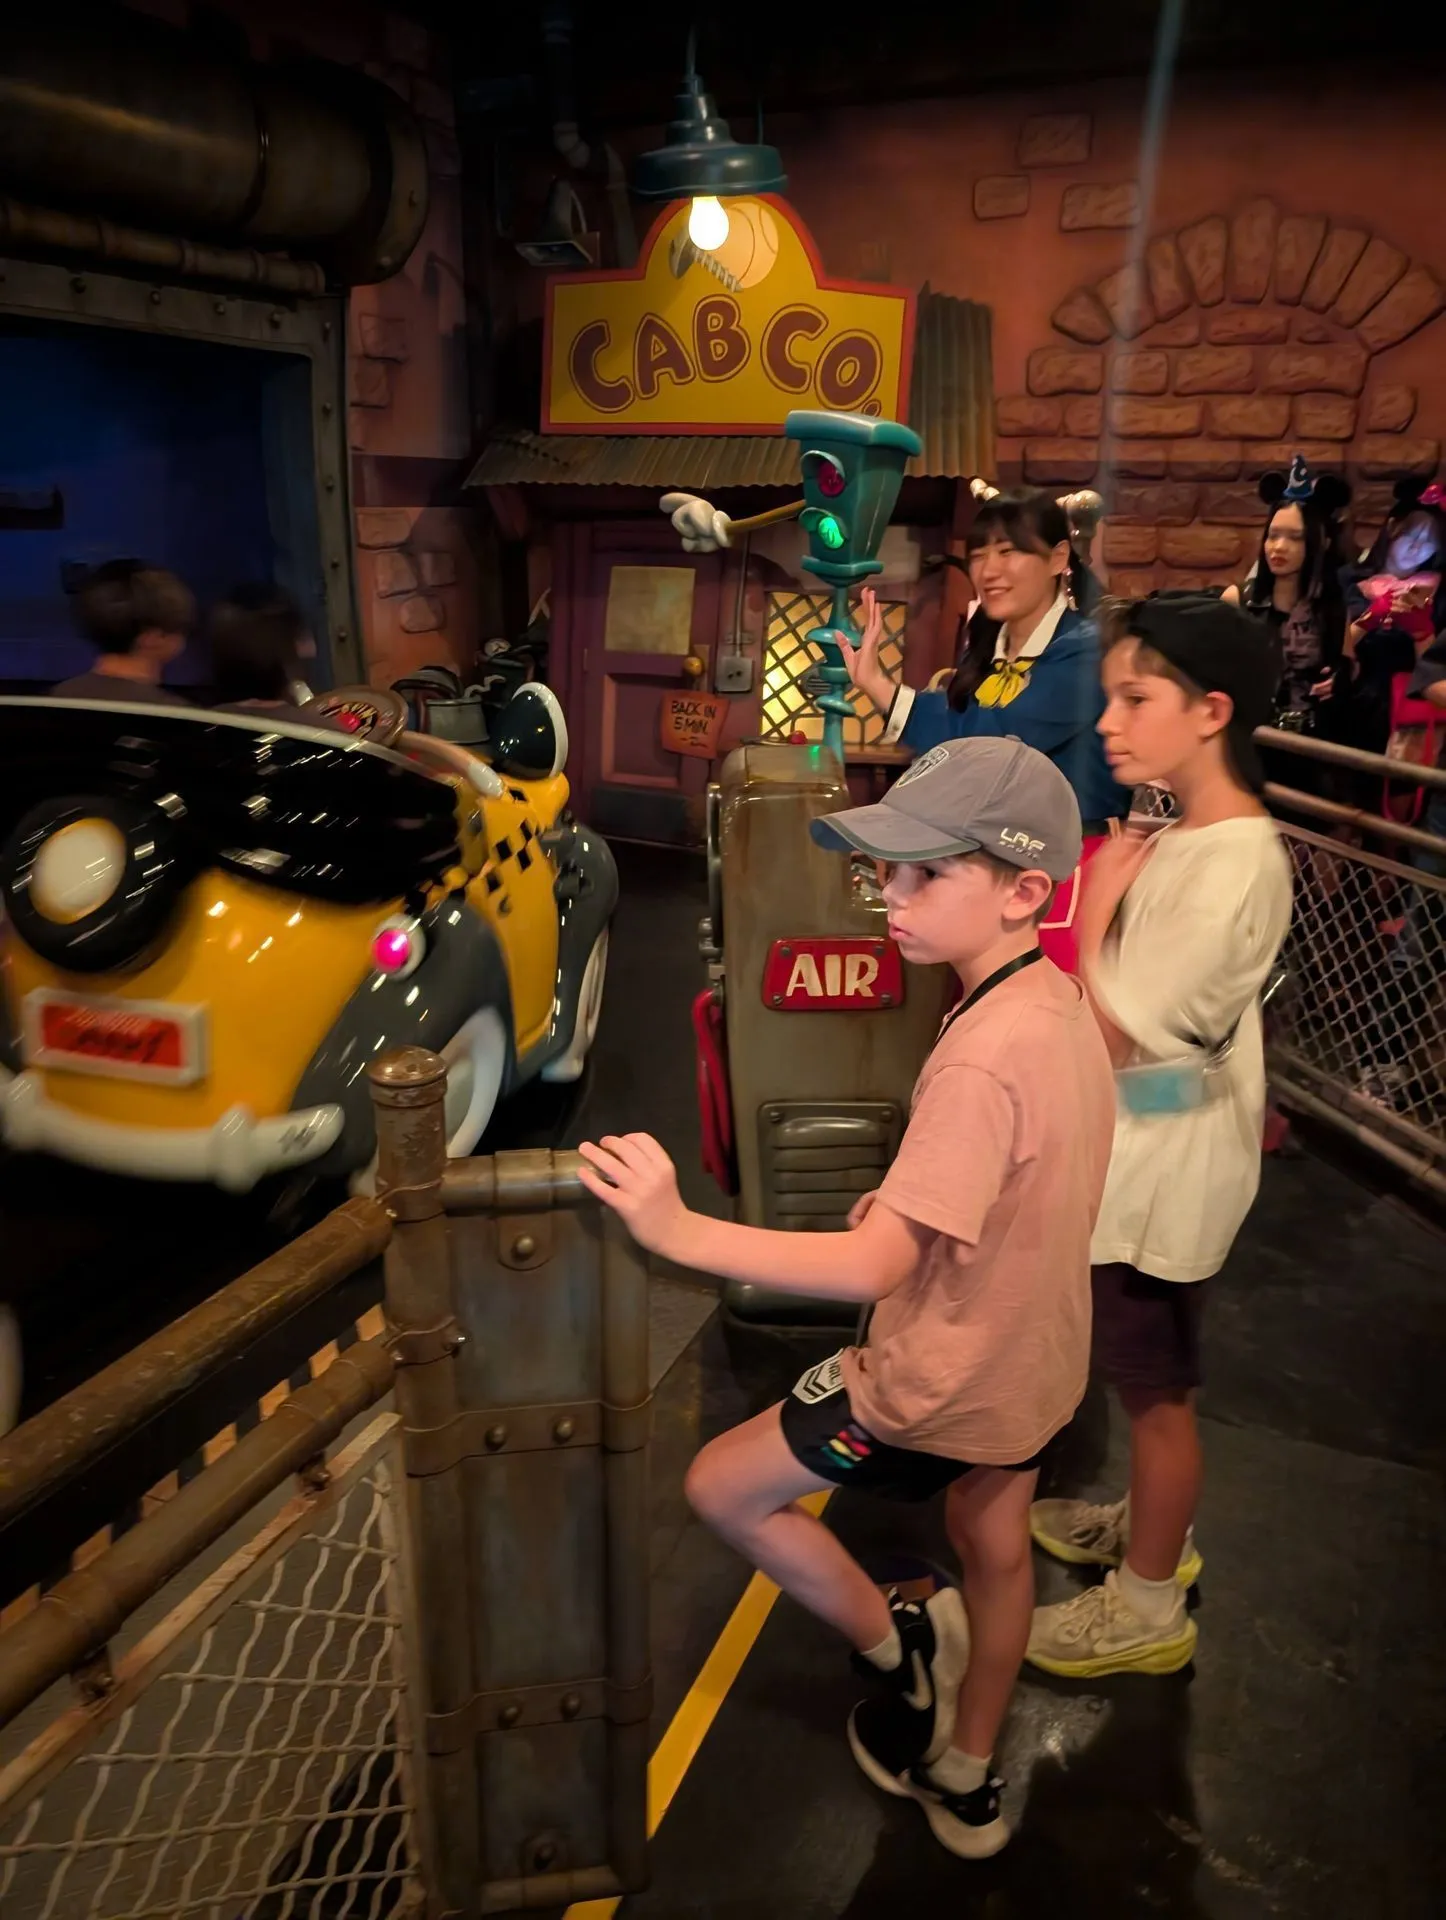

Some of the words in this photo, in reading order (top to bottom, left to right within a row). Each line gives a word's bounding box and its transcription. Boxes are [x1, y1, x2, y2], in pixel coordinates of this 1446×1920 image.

[671, 700, 703, 717] BACK
[704, 704, 717, 720] IN
[674, 716, 682, 730] 5
[785, 953, 880, 998] AIR
